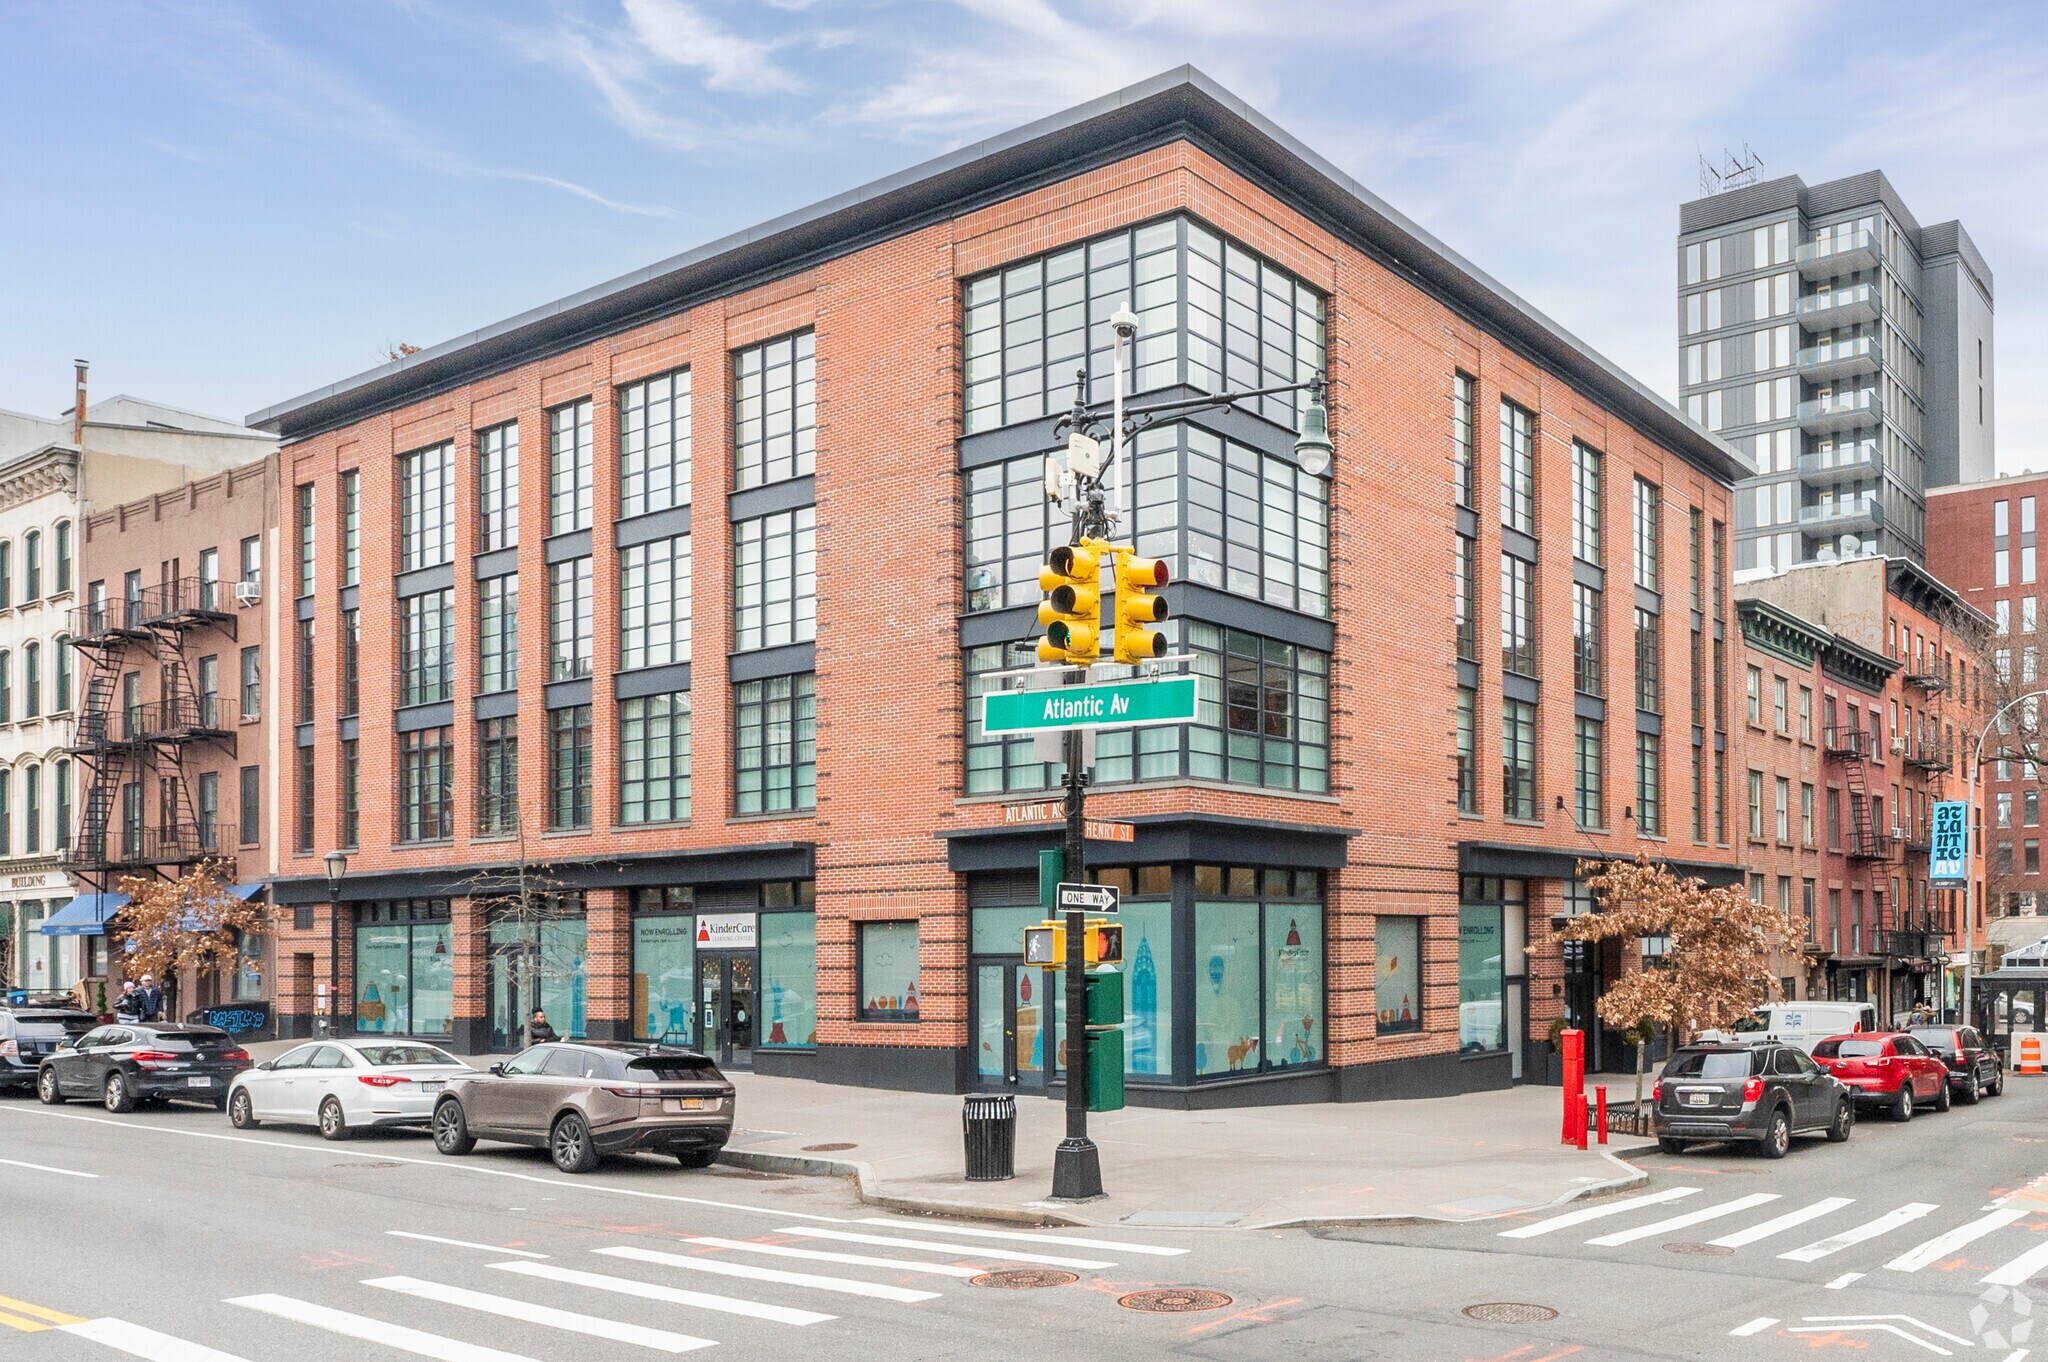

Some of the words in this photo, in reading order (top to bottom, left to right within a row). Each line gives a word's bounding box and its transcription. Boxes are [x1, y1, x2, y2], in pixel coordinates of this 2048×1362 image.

[1043, 694, 1104, 720] Atlantic
[1109, 692, 1130, 715] Av
[1005, 803, 1047, 823] ATLANTIC
[1085, 821, 1116, 839] HENRY
[1120, 824, 1131, 840] ST
[11, 875, 46, 888] BUILDING
[1066, 893, 1085, 904] ONE
[1092, 894, 1110, 905] WAY
[640, 928, 654, 936] NOW
[655, 927, 688, 936] ENROLLING
[710, 922, 755, 934] KinderCare
[16, 996, 23, 1005] P
